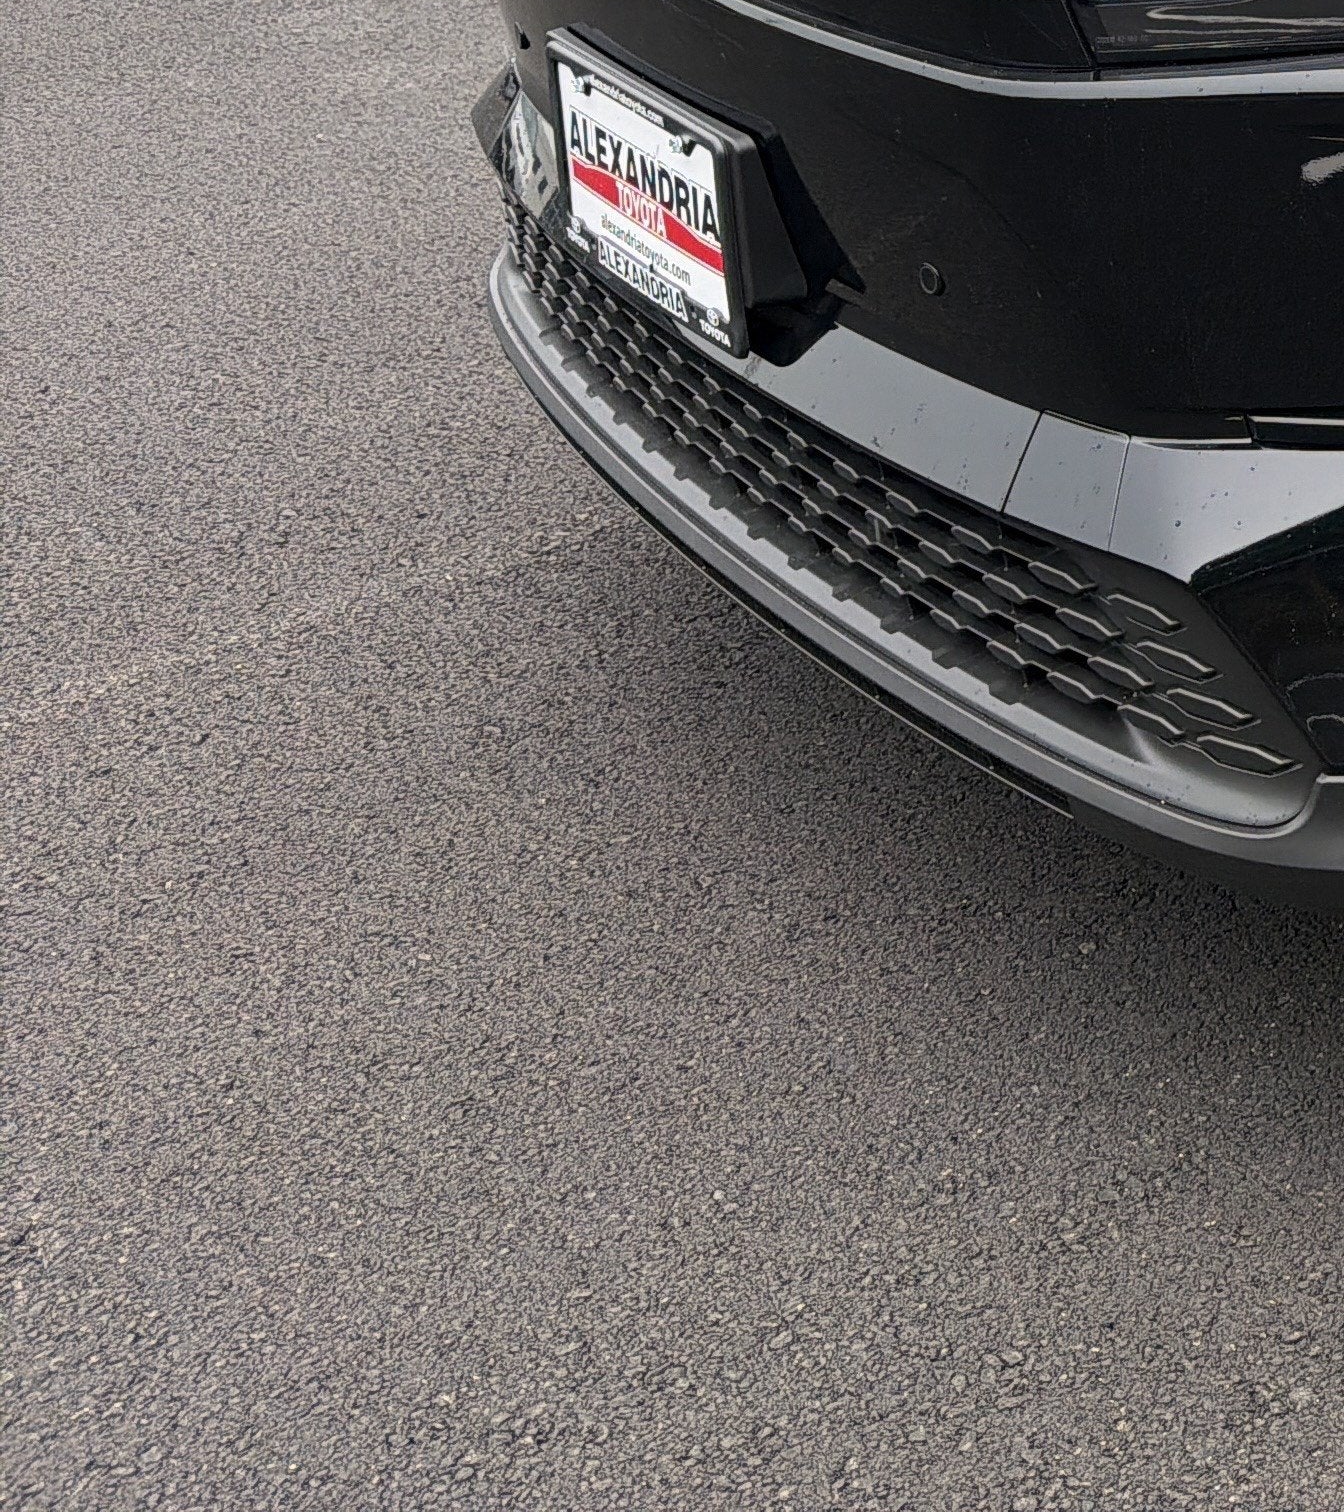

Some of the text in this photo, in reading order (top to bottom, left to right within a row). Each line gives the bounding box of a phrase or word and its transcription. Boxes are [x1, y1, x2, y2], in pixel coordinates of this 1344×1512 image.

[569, 110, 720, 239] ALEXANDRIA
[615, 181, 668, 238] TOYOTA
[599, 238, 688, 323] ALEXANDRIA
[600, 212, 692, 286] alexandriatoyota.com
[699, 318, 731, 348] TOYOTA
